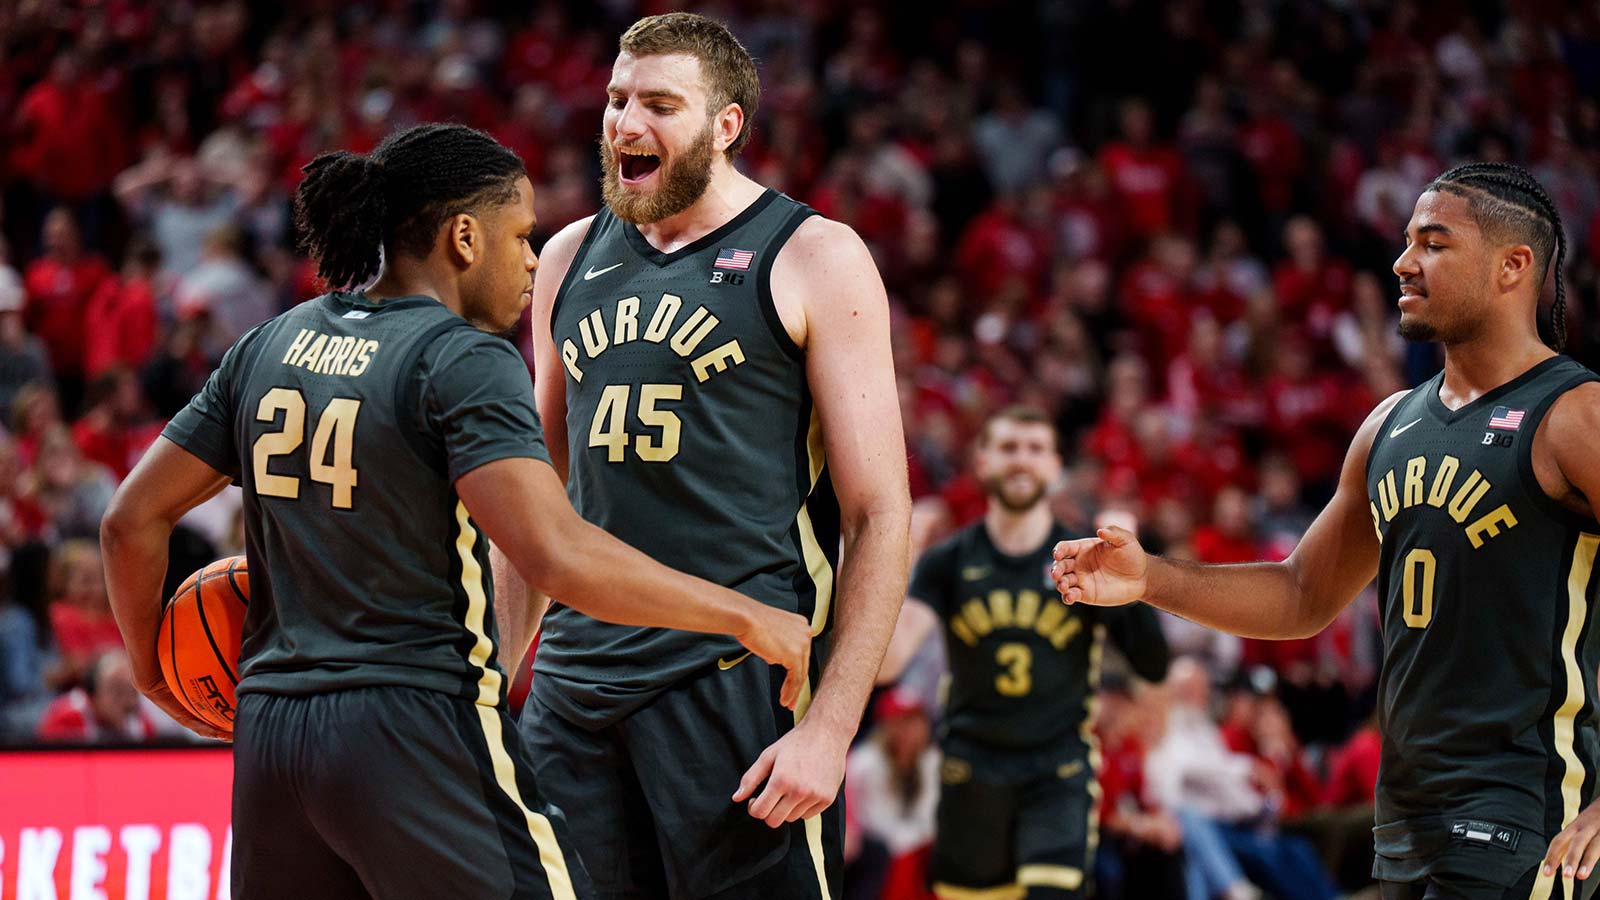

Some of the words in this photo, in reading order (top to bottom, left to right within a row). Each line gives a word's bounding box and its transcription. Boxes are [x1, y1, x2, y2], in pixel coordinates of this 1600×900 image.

[281, 328, 379, 377] HARRIS
[562, 292, 747, 384] PURDUE
[252, 387, 361, 509] 24
[588, 383, 684, 463] 45
[1402, 548, 1437, 629] 0
[995, 642, 1033, 697] 3
[0, 822, 232, 900] KETB
[1496, 831, 1510, 843] 46
